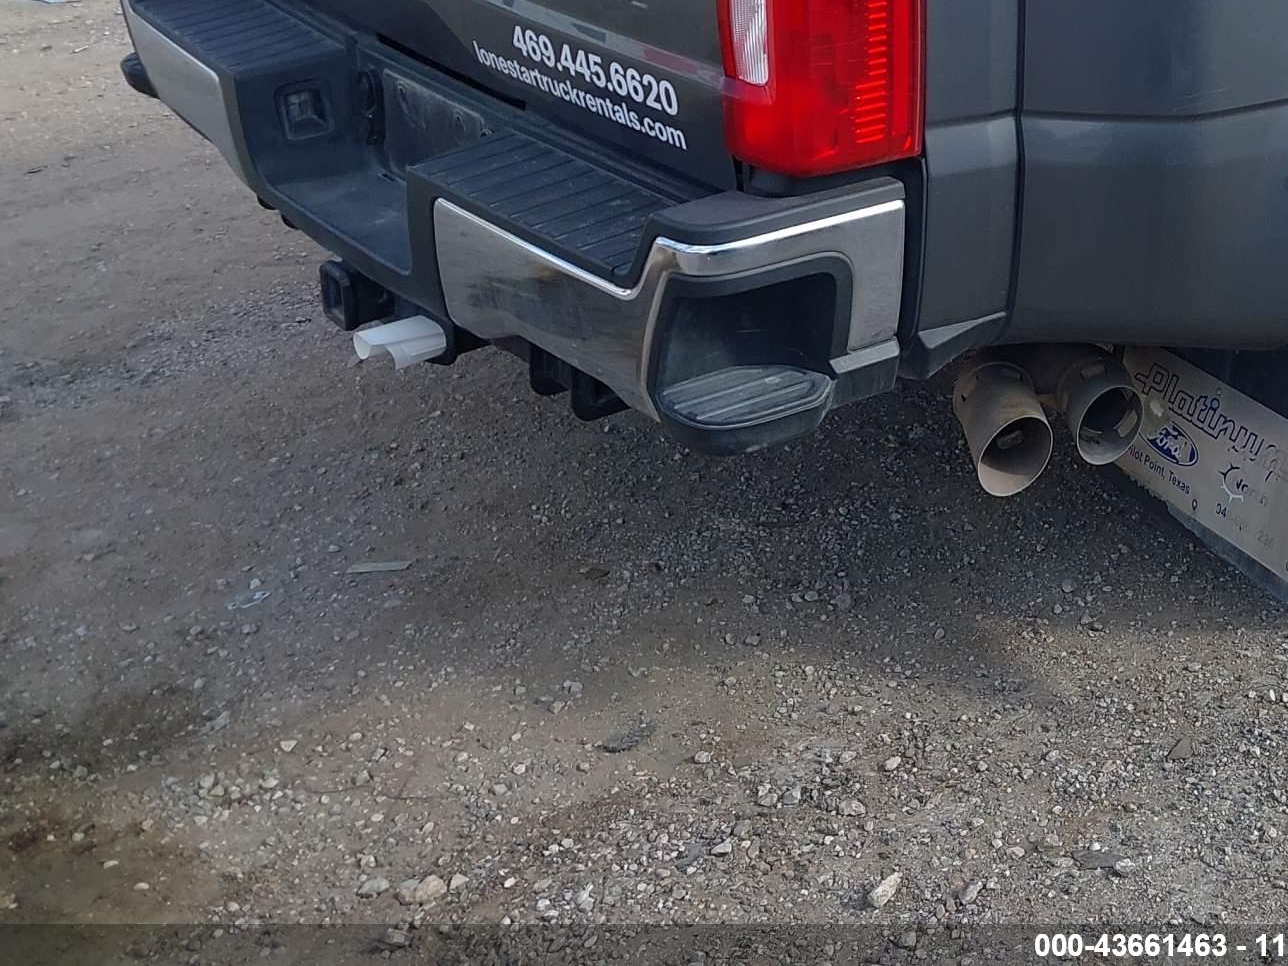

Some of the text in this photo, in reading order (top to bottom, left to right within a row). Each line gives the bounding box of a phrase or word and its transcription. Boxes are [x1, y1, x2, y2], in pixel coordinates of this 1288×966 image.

[472, 39, 688, 150] lonestartruckrentals.com
[512, 25, 679, 116] 469.445.6620
[1168, 470, 1190, 494] Texas
